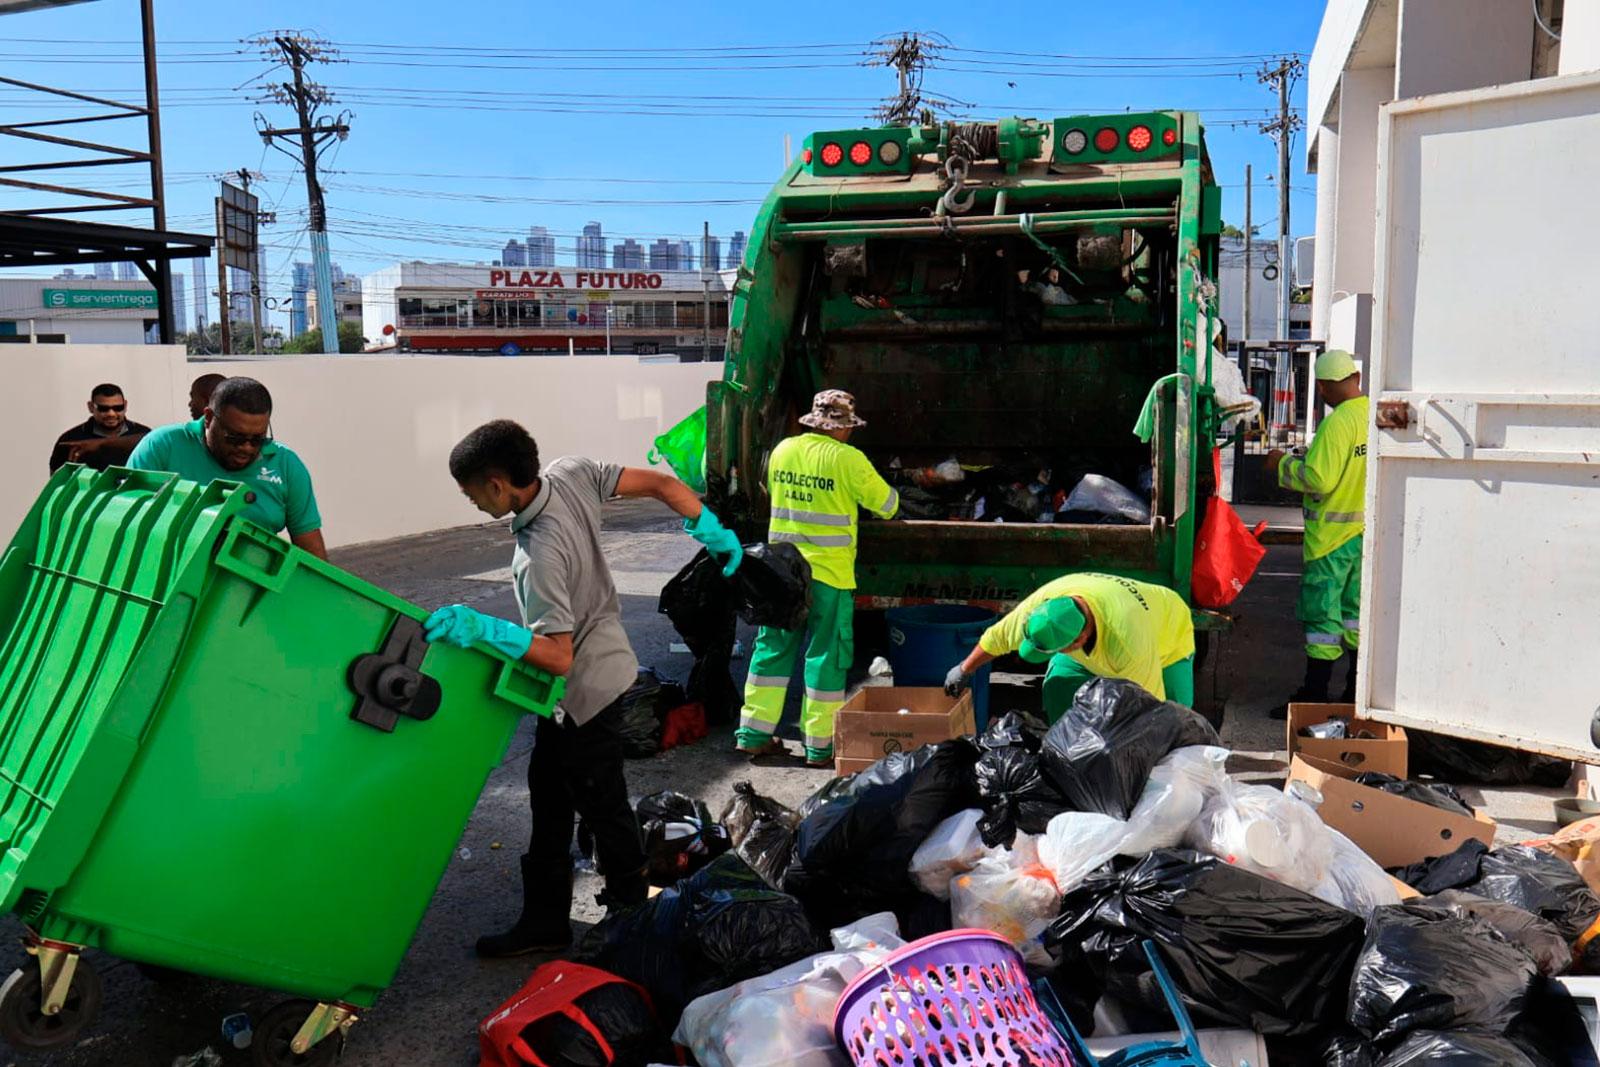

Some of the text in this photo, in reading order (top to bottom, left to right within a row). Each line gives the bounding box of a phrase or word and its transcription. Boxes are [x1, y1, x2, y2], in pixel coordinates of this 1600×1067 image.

[490, 270, 662, 289] PLAZA FUTURO
[72, 294, 153, 306] servientrega
[903, 583, 1019, 600] McNeilus
